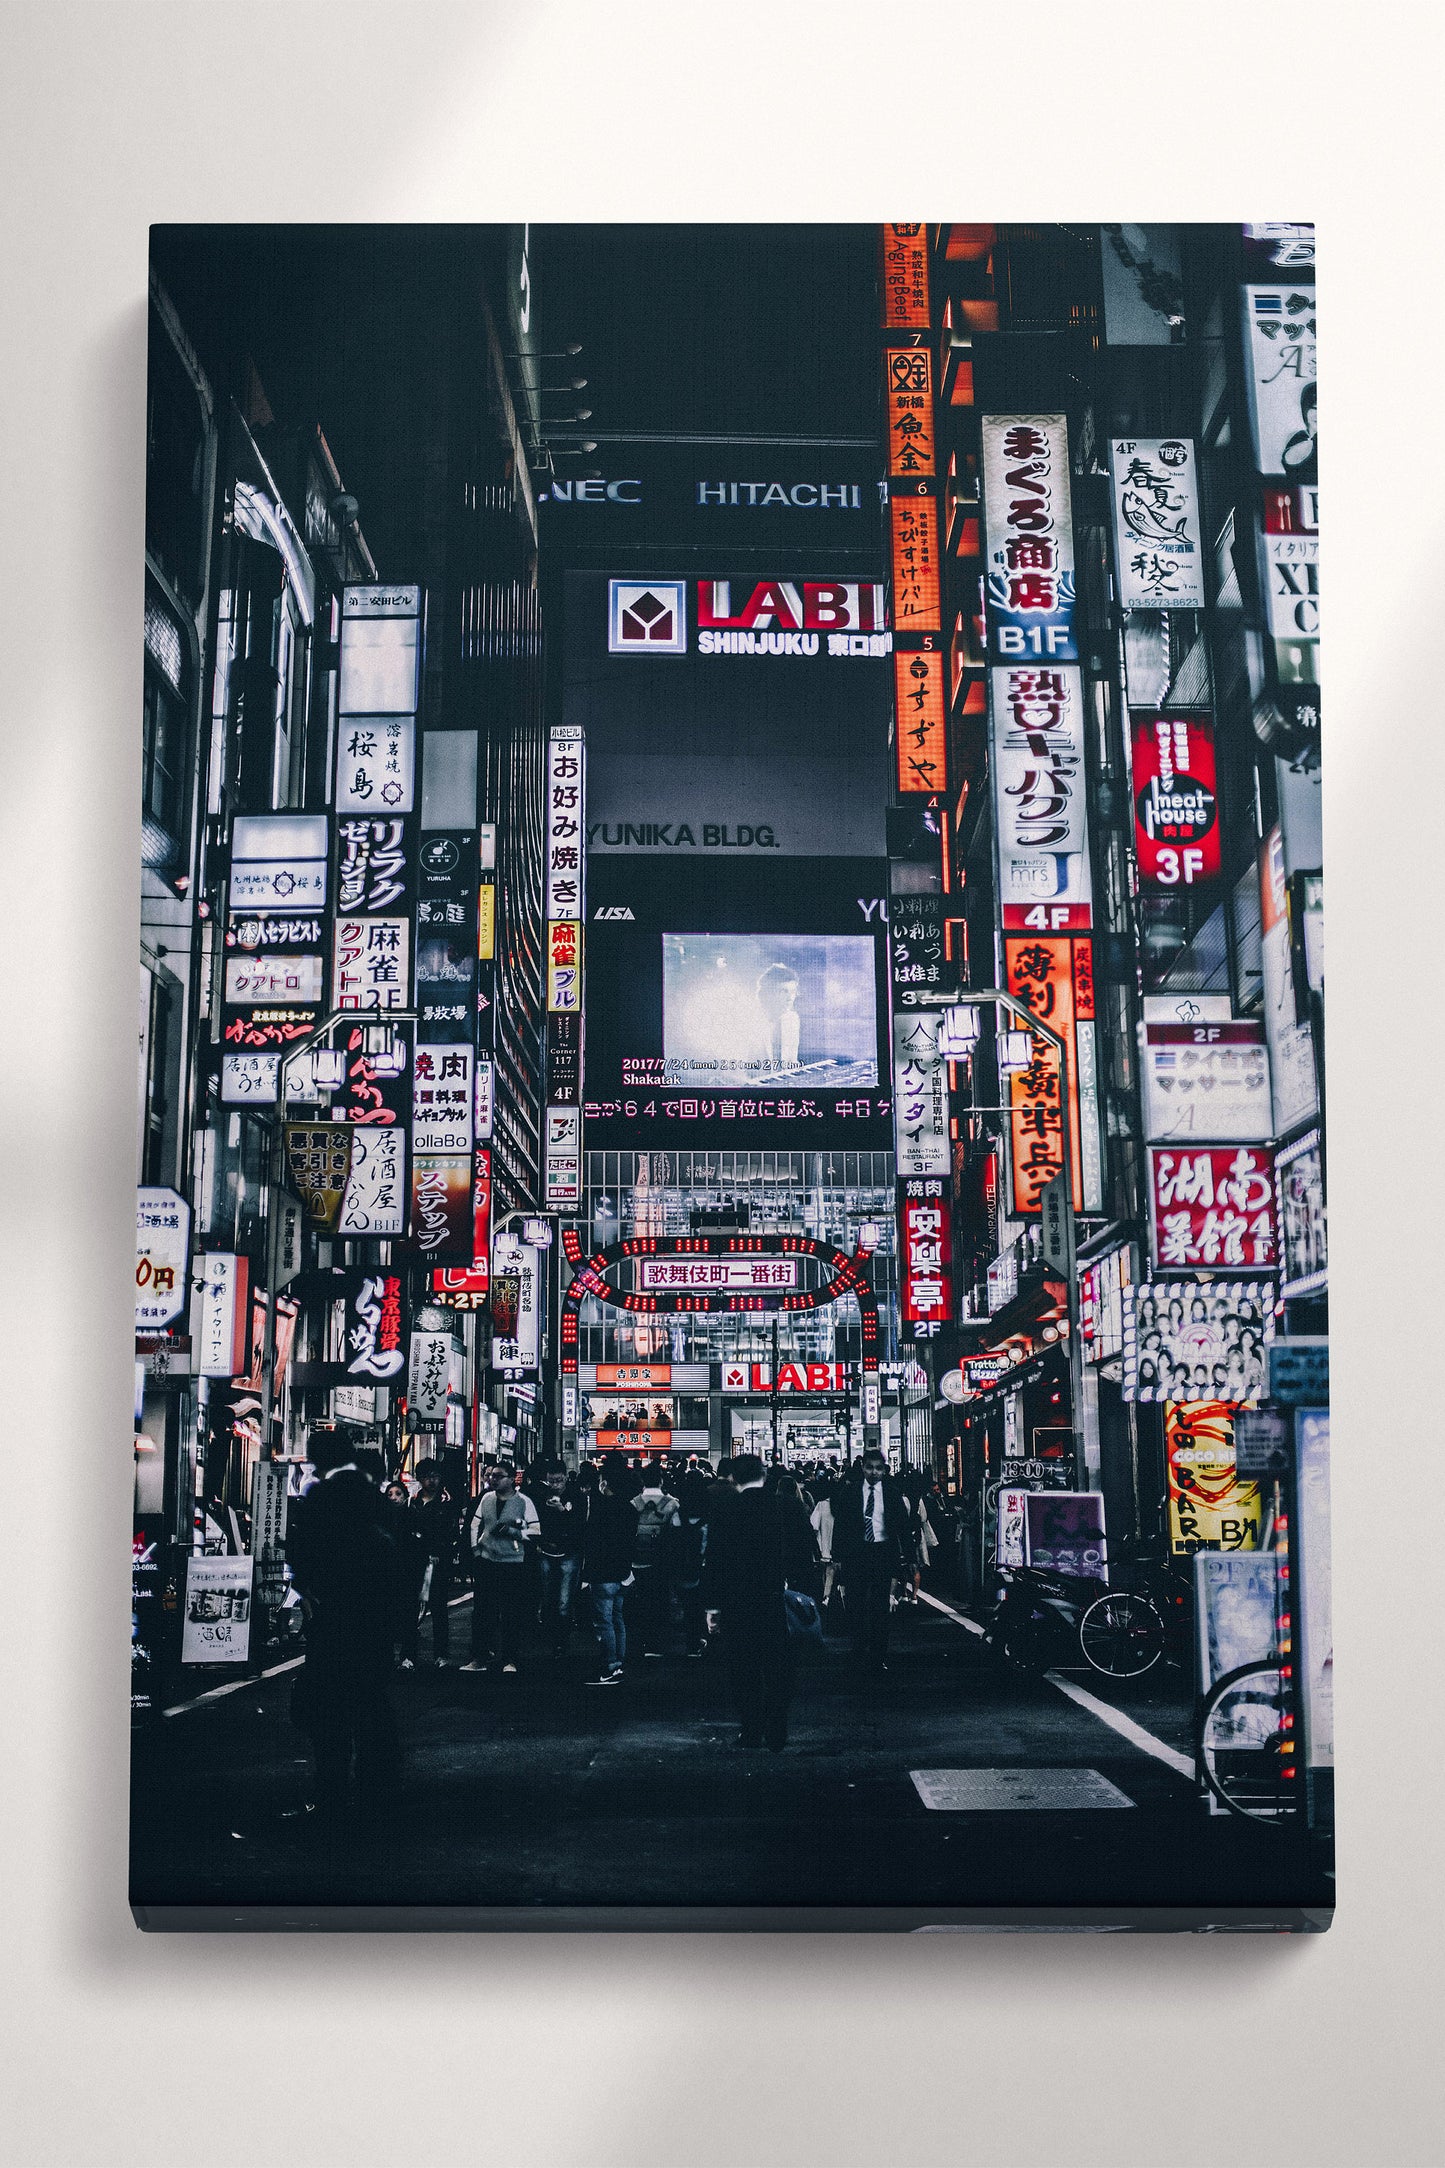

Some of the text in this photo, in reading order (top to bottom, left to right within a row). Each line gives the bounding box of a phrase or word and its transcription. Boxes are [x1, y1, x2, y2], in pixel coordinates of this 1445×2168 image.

[888, 240, 910, 285] Aging
[894, 286, 912, 321] Beef
[909, 333, 922, 347] 7
[896, 396, 925, 409] 新橋
[893, 412, 932, 472] 魚金
[1116, 443, 1137, 454] 4F
[552, 480, 861, 508] NEC HITACHI
[918, 482, 927, 495] 6
[1003, 426, 1056, 612] まぐろ商店
[349, 596, 412, 607] 第二安田ビル
[697, 580, 885, 631] LABI
[698, 631, 819, 656] SHINJUKU
[924, 637, 933, 651] 5
[999, 625, 1070, 655] B1F
[558, 743, 574, 751] 8F
[347, 731, 377, 800] 桜島
[927, 797, 938, 808] 4
[552, 756, 579, 903] お好み焼き
[1146, 800, 1207, 840] house
[586, 823, 781, 848] YUNIKA BLDG.
[1156, 849, 1203, 884] 3F
[556, 909, 573, 918] 7F
[1025, 905, 1069, 930] 4F
[238, 920, 321, 944] 本人セラピスト
[367, 923, 400, 984] 麻雀
[236, 976, 300, 991] クアトロ
[1194, 1028, 1221, 1042] 2F
[225, 1058, 276, 1072] 居酒屋
[555, 1056, 571, 1065] 117
[622, 1073, 681, 1085] Shakatak
[414, 1090, 467, 1104] 国料理
[554, 1087, 573, 1100] 4F
[901, 1058, 927, 1143] バンタイ
[931, 1058, 944, 1136] タイ国料理専門店
[369, 1130, 397, 1210] 居酒屋
[549, 1160, 576, 1170] たばこ
[914, 1162, 933, 1172] 3F
[906, 1180, 943, 1198] 焼肉
[986, 1184, 997, 1241] ANRAKUTEI
[908, 1206, 943, 1312] 安楽亭
[648, 1264, 792, 1285] 歌舞伎町一番街
[381, 1276, 401, 1351] 東京豚骨
[913, 1321, 941, 1338] 2F
[421, 1340, 447, 1411] お好み焼き
[504, 1369, 524, 1380] 2F
[616, 1368, 651, 1379] 吉野家
[751, 1363, 848, 1391] LABI
[616, 1433, 652, 1444] 吉野家
[1209, 1561, 1243, 1584] 2F
